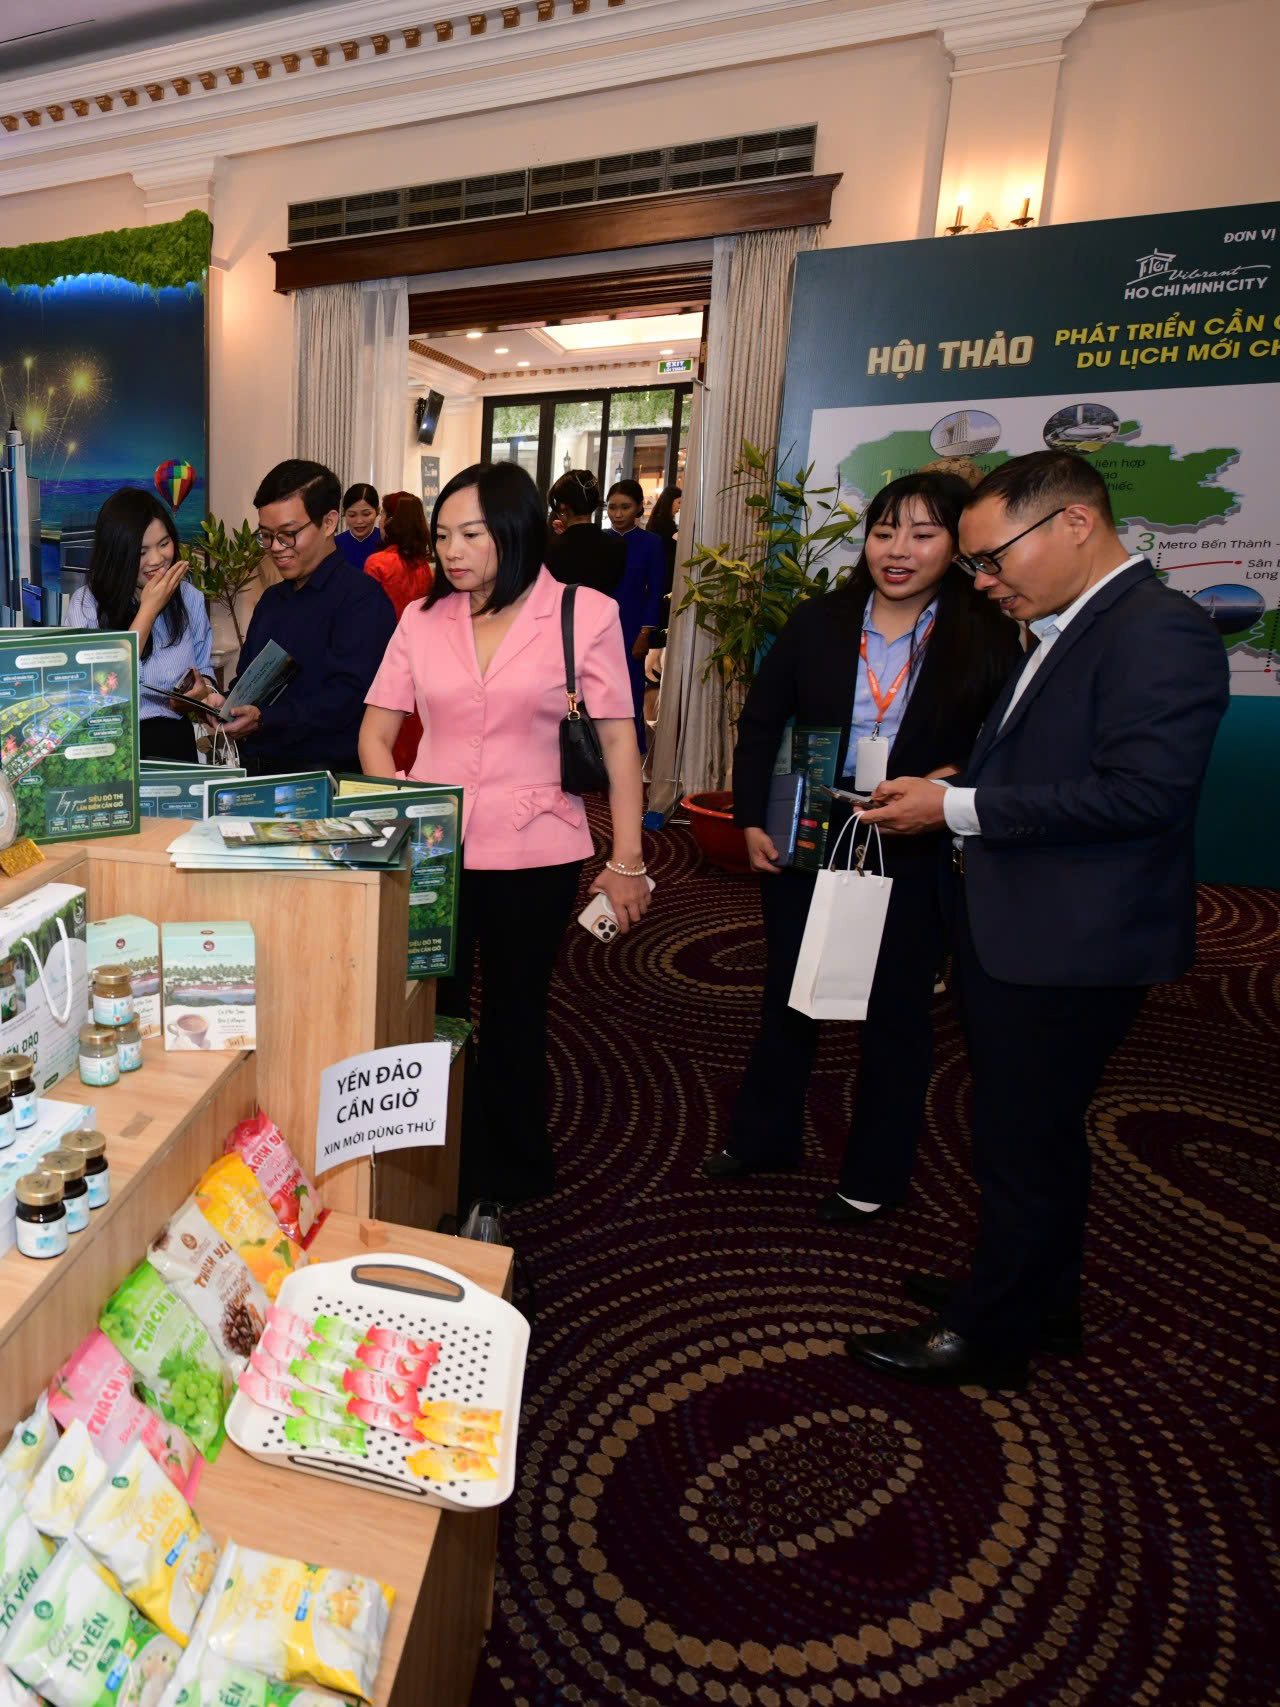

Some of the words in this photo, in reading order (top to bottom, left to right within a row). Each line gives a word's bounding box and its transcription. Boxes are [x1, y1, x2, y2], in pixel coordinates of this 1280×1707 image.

[1224, 229, 1257, 243] ĐƠN
[1261, 228, 1276, 241] VỊ
[1124, 286, 1150, 300] HO
[1151, 284, 1180, 298] CHI
[1181, 280, 1224, 295] MINH
[1226, 277, 1268, 291] CITY
[1055, 322, 1120, 345] PHÁT
[1127, 312, 1196, 341] TRIỂN
[1204, 307, 1265, 335] CẦN
[867, 339, 926, 382] HỘI
[938, 330, 1034, 370] THẢO
[1076, 349, 1112, 368] DU
[1119, 346, 1179, 370] LỊCH
[1186, 338, 1240, 362] MỚI
[1136, 532, 1156, 552] 3
[1158, 541, 1197, 550] Metro
[1201, 539, 1226, 549] Bến
[1230, 539, 1271, 549] Thành
[1245, 571, 1278, 581] Long
[1248, 559, 1272, 568] Sân
[337, 1067, 371, 1095] YẾN
[376, 1058, 422, 1084] ĐẢO
[336, 1096, 374, 1124] CẦN
[380, 1088, 420, 1111] GIỜ
[324, 1140, 341, 1156] XIN
[342, 1131, 365, 1148] MỜI
[368, 1124, 403, 1141] DÙNG
[407, 1118, 436, 1133] THỬ
[16, 1565, 39, 1601] YẾN
[66, 1640, 89, 1672] TỔ
[82, 1611, 110, 1648] YẾN
[220, 1681, 247, 1707] ẾN
